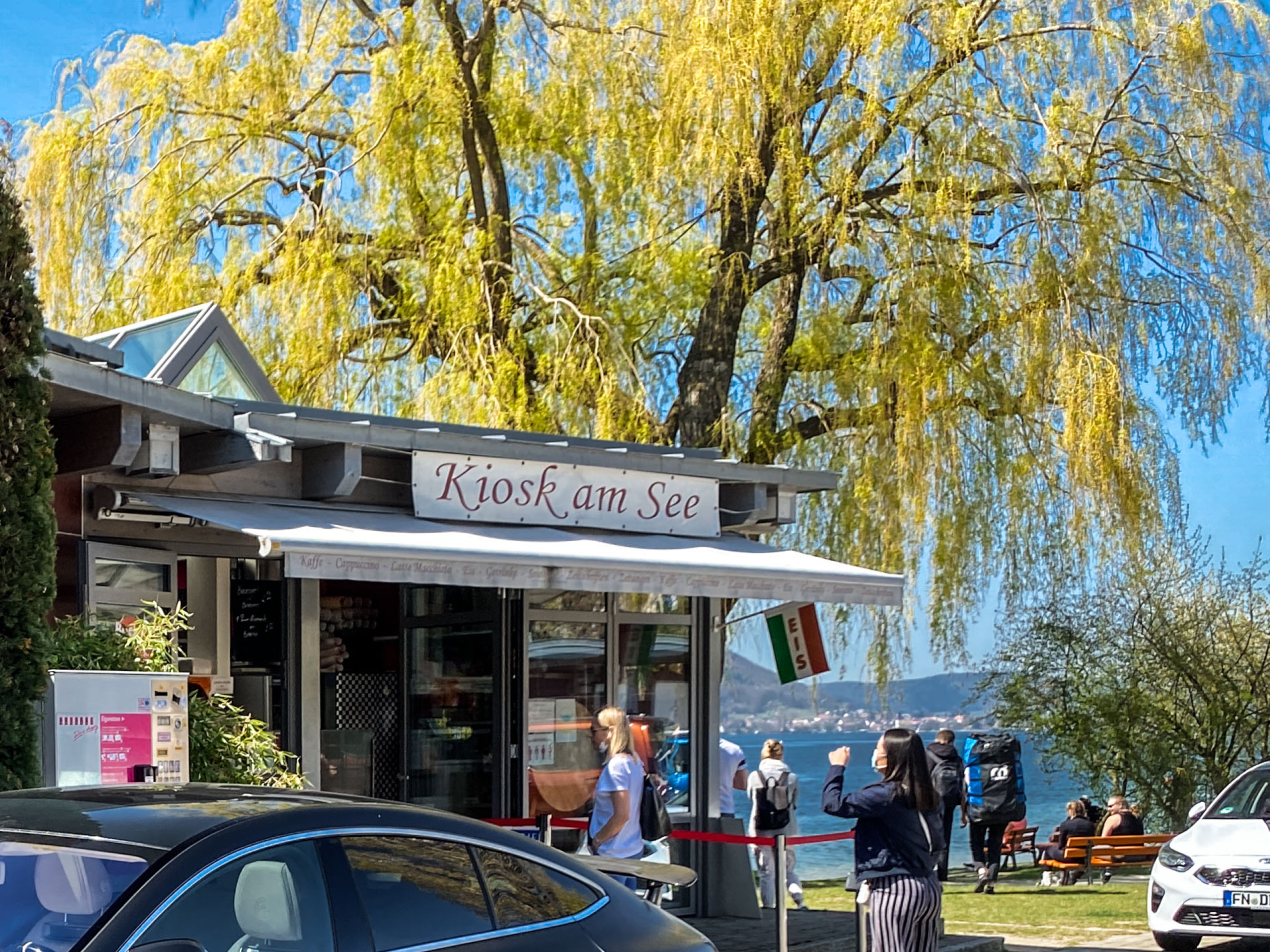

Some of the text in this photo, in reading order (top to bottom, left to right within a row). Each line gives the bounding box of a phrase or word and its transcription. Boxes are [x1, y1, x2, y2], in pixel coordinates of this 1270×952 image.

[435, 464, 701, 520] Kiosk am See
[787, 617, 808, 670] EIS
[1233, 893, 1270, 906] FN D
